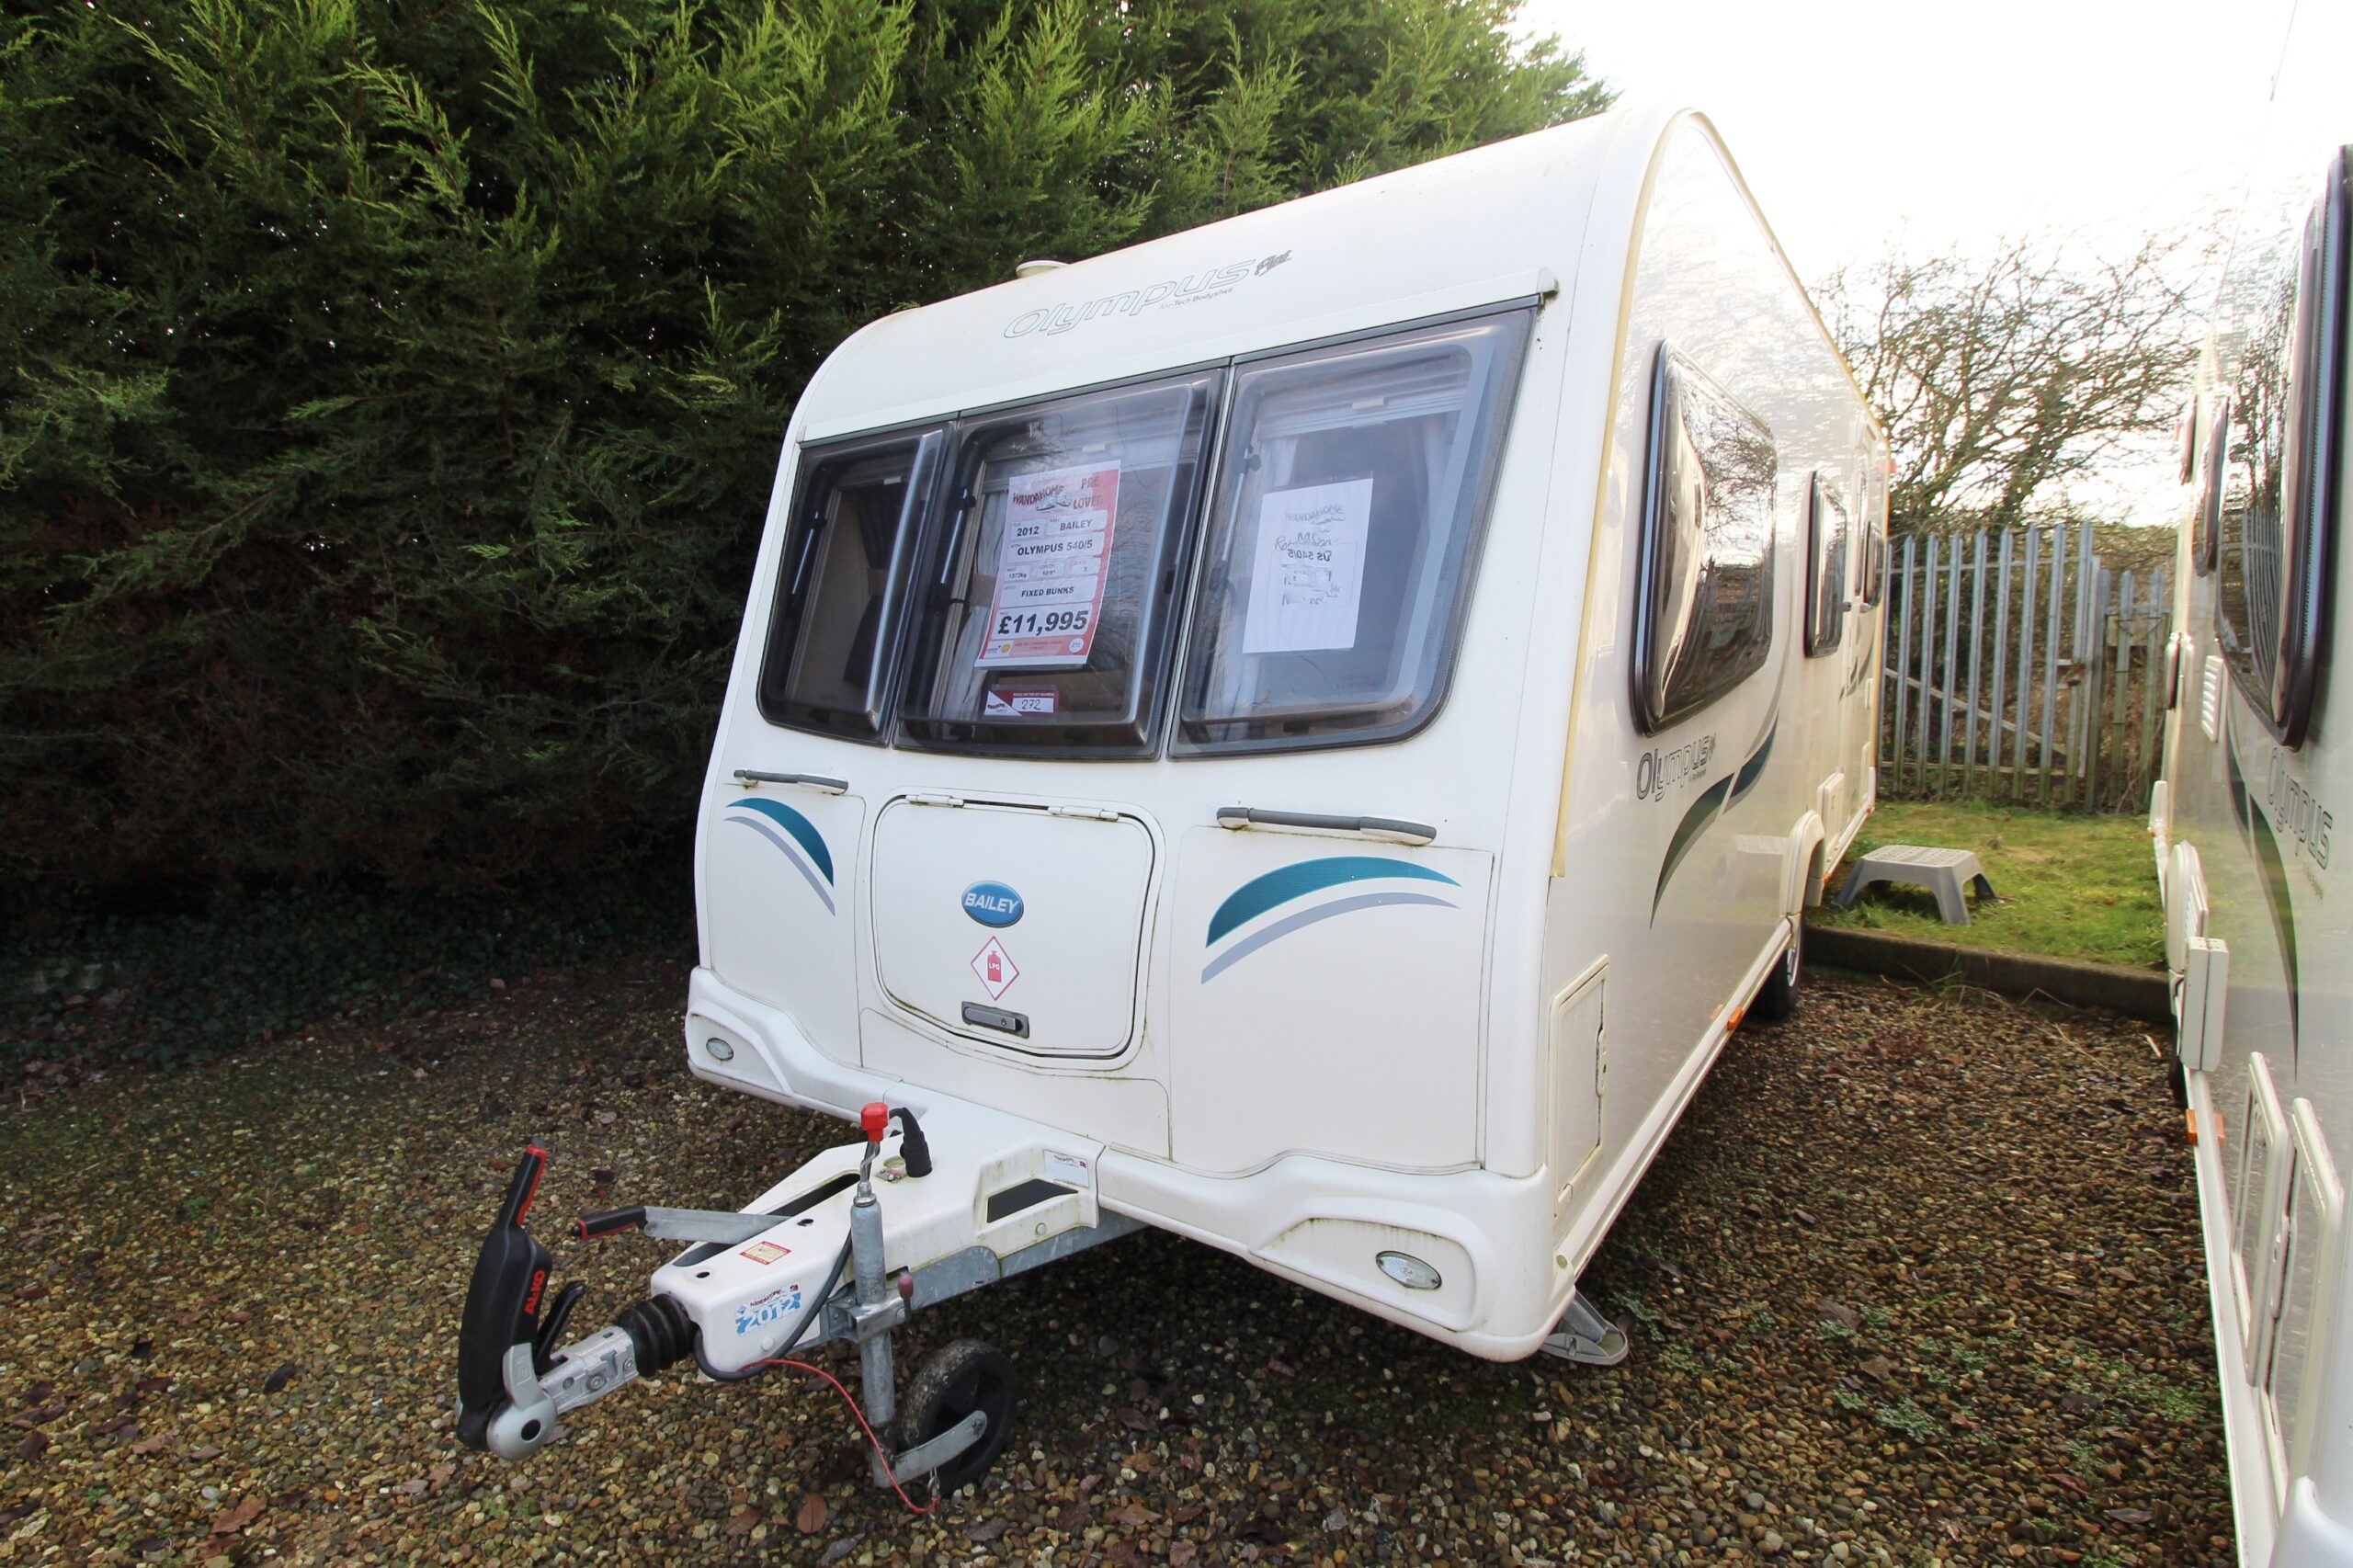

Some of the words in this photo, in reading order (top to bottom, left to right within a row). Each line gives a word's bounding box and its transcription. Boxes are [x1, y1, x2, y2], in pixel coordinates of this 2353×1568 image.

[1017, 526, 1040, 537] 2012
[1060, 518, 1094, 531] BAILEY
[1017, 542, 1064, 556] OLYMPUS
[1066, 540, 1094, 551] 540/5
[1021, 589, 1044, 597] FIXED
[1046, 586, 1074, 596] BUNKS
[997, 609, 1089, 637] £11,995
[1021, 699, 1042, 711] 272
[965, 892, 1020, 914] BAILEY
[988, 962, 1000, 971] LPG
[524, 1269, 546, 1316] AL-KO
[738, 1294, 801, 1336] 2012
